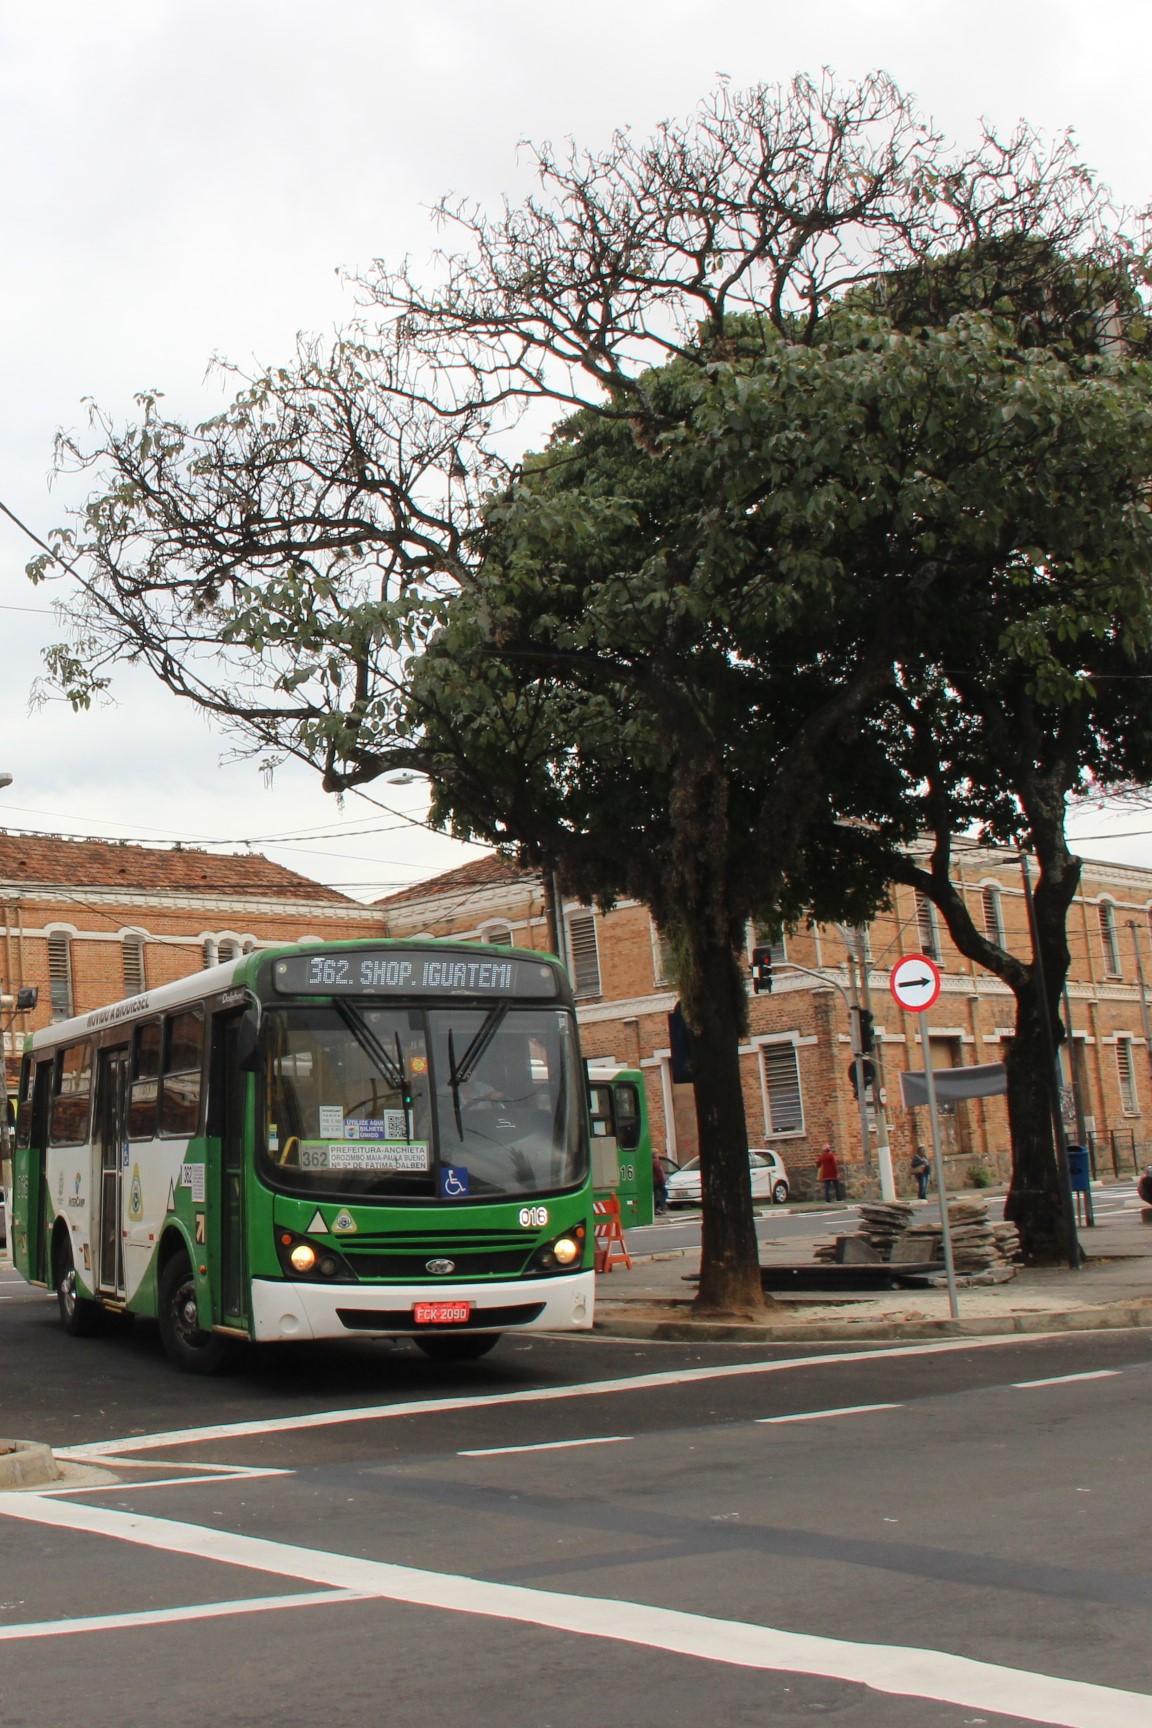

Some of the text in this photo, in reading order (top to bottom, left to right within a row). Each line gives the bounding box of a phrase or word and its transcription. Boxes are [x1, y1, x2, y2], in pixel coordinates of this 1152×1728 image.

[309, 958, 512, 988] 362. SHOP. IGUATEMI
[330, 1146, 425, 1154] PREFEITURA-ANCHIETA
[303, 1151, 328, 1167] 362
[352, 1161, 364, 1169] DE
[519, 1206, 548, 1227] 016
